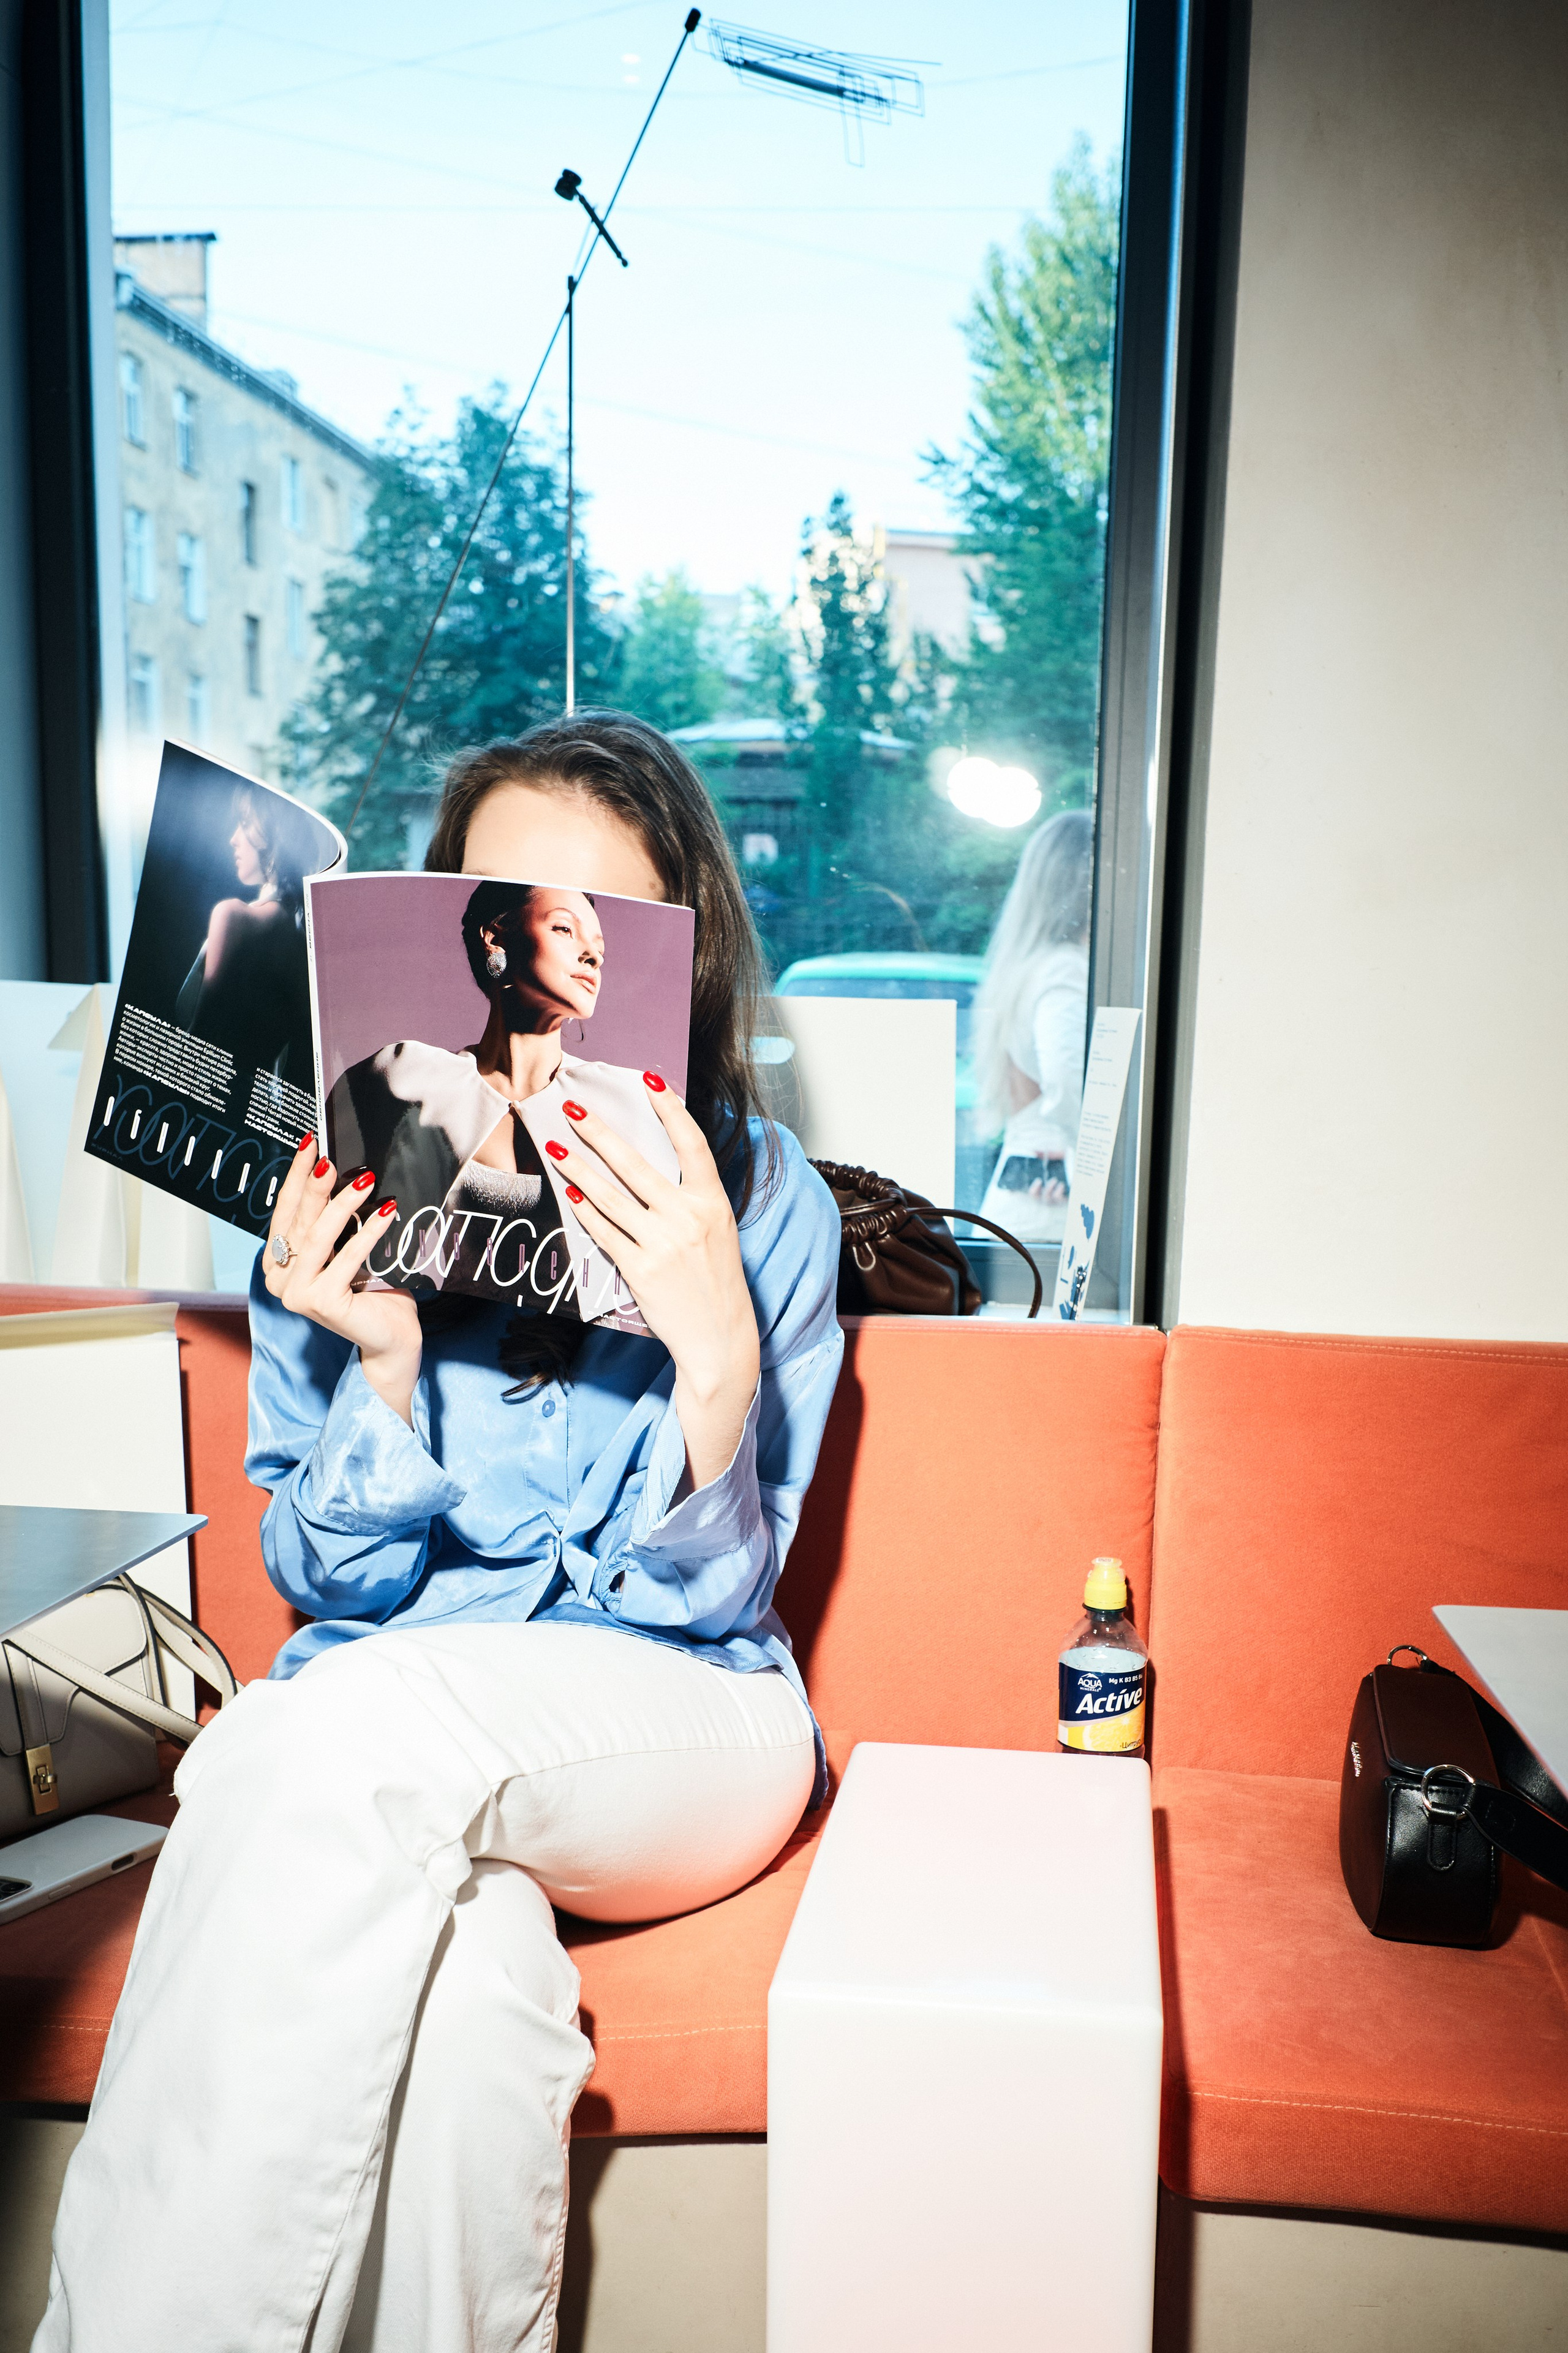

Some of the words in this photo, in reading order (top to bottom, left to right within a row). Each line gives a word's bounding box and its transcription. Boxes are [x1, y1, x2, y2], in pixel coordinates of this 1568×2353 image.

[121, 1022, 129, 1030] без
[129, 1027, 149, 1040] которых
[149, 1037, 167, 1048] сложно
[167, 1045, 195, 1062] представить
[195, 1058, 210, 1069] будни
[209, 1066, 233, 1079] петербур-
[123, 1010, 156, 1028] косметологии
[159, 1027, 181, 1040] лазерной
[181, 1038, 203, 1051] эпиляции
[220, 1056, 233, 1066] Clinic
[126, 1019, 141, 1029] жизни
[144, 1026, 166, 1040] большом
[165, 1038, 183, 1049] городе.
[183, 1045, 200, 1057] Внутри
[200, 1054, 217, 1065] четыре
[217, 1062, 237, 1076] раздела,
[205, 1042, 217, 1051] сети
[216, 1048, 233, 1059] клиник
[116, 1043, 137, 1056] которые
[136, 1052, 156, 1065] волнуют
[162, 1065, 176, 1075] самих
[180, 1073, 200, 1086] близкий
[119, 1051, 137, 1062] первом
[136, 1060, 154, 1072] номере,
[155, 1068, 170, 1078] темой
[169, 1076, 191, 1089] которого
[190, 1086, 205, 1095] стало
[204, 1092, 226, 1105] обновле-
[158, 1056, 175, 1067] честно
[178, 1065, 194, 1076] просто
[194, 1073, 213, 1085] говорят
[217, 1084, 232, 1095] темах,
[182, 1060, 195, 1069] мода
[198, 1068, 211, 1077] стиль
[211, 1074, 227, 1085] жизни.
[113, 1056, 123, 1064] ние,
[123, 1061, 143, 1073] команда
[190, 1093, 212, 1106] подводит
[212, 1103, 226, 1113] итоги
[296, 1124, 311, 1134] номе
[351, 1278, 384, 1286] УРНАЛ
[598, 1313, 650, 1328] НАСТОЯЩЕ
[1078, 1677, 1102, 1688] AQUA
